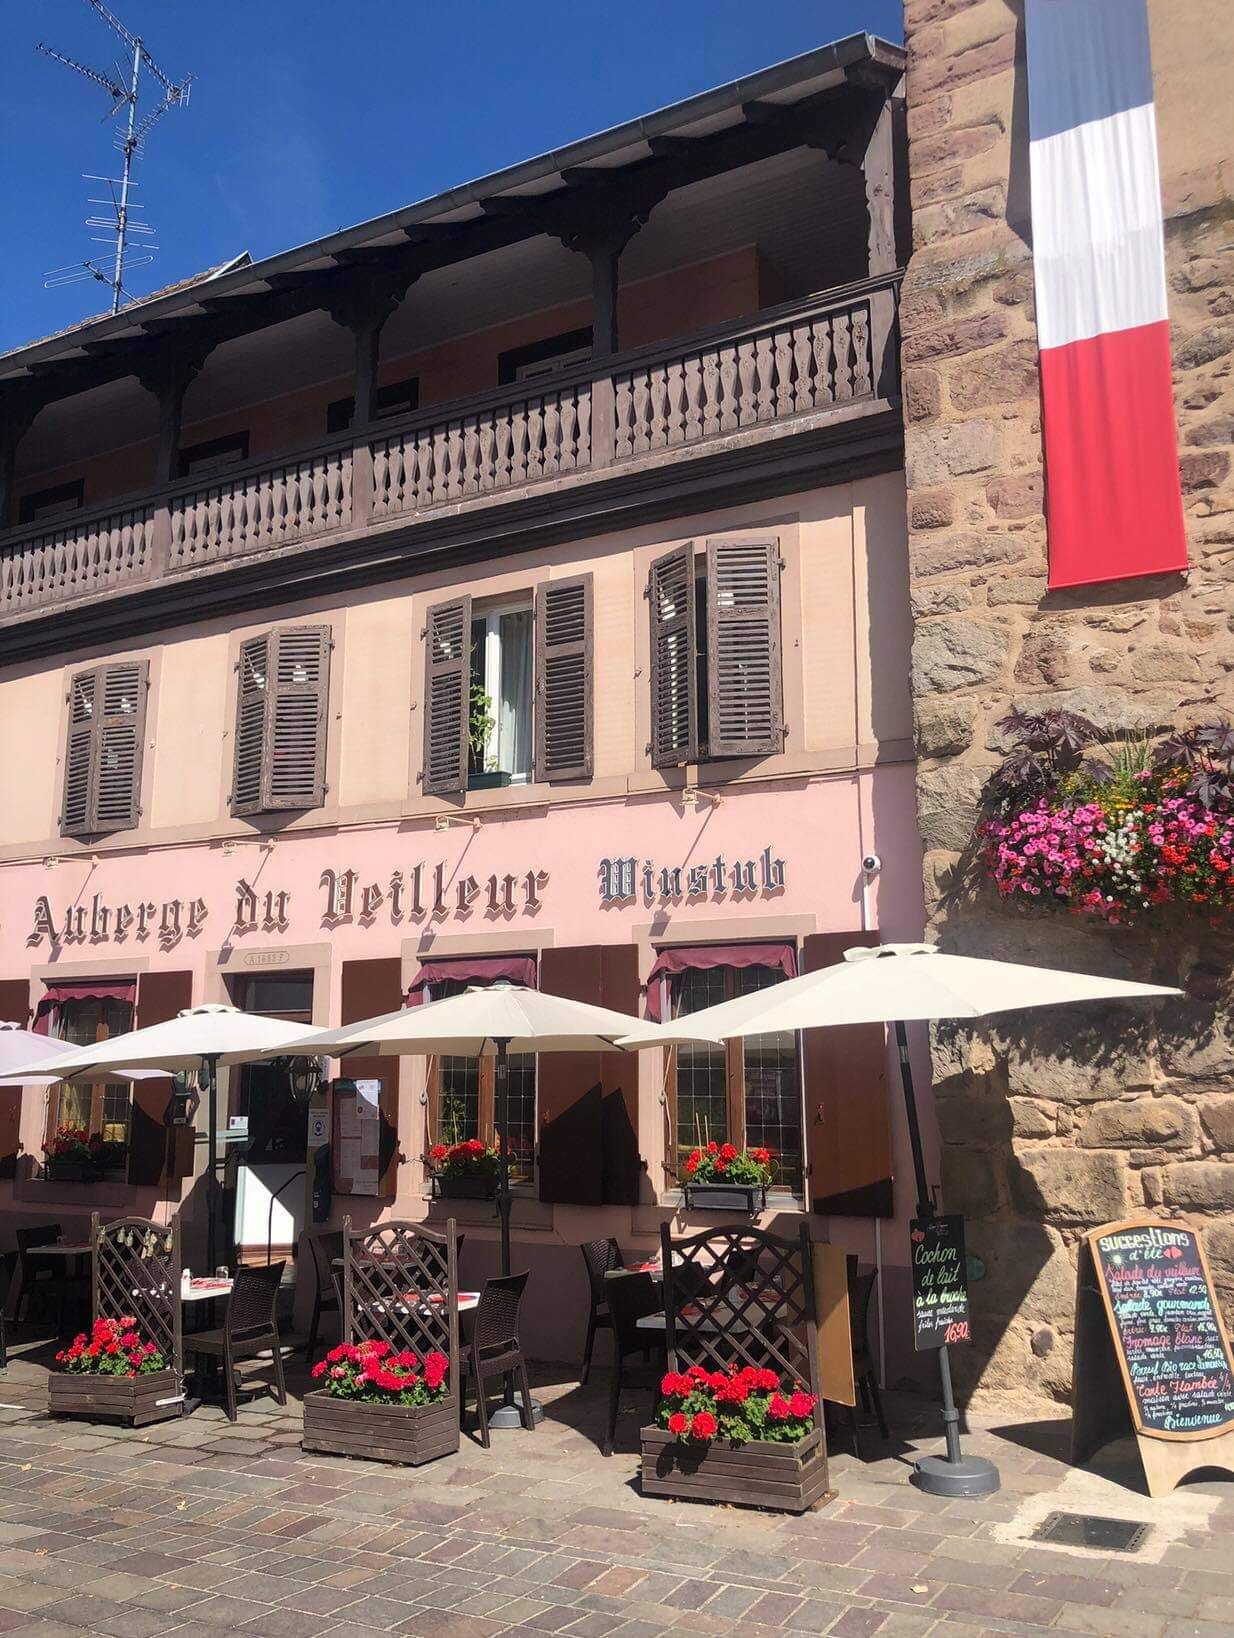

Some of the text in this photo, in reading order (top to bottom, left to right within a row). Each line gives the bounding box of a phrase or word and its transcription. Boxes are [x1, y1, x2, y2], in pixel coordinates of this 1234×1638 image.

[598, 845, 785, 907] Winstub
[26, 860, 549, 951] Auberge du Veilleur
[915, 1242, 957, 1264] Cochon
[921, 1262, 961, 1286] de lait
[915, 1290, 926, 1308] à
[925, 1288, 938, 1304] la
[1122, 1335, 1171, 1350] Fromage
[1174, 1331, 1203, 1345] blanc
[1170, 1376, 1219, 1394] Flambée
[1164, 1413, 1222, 1430] Bienvenue
